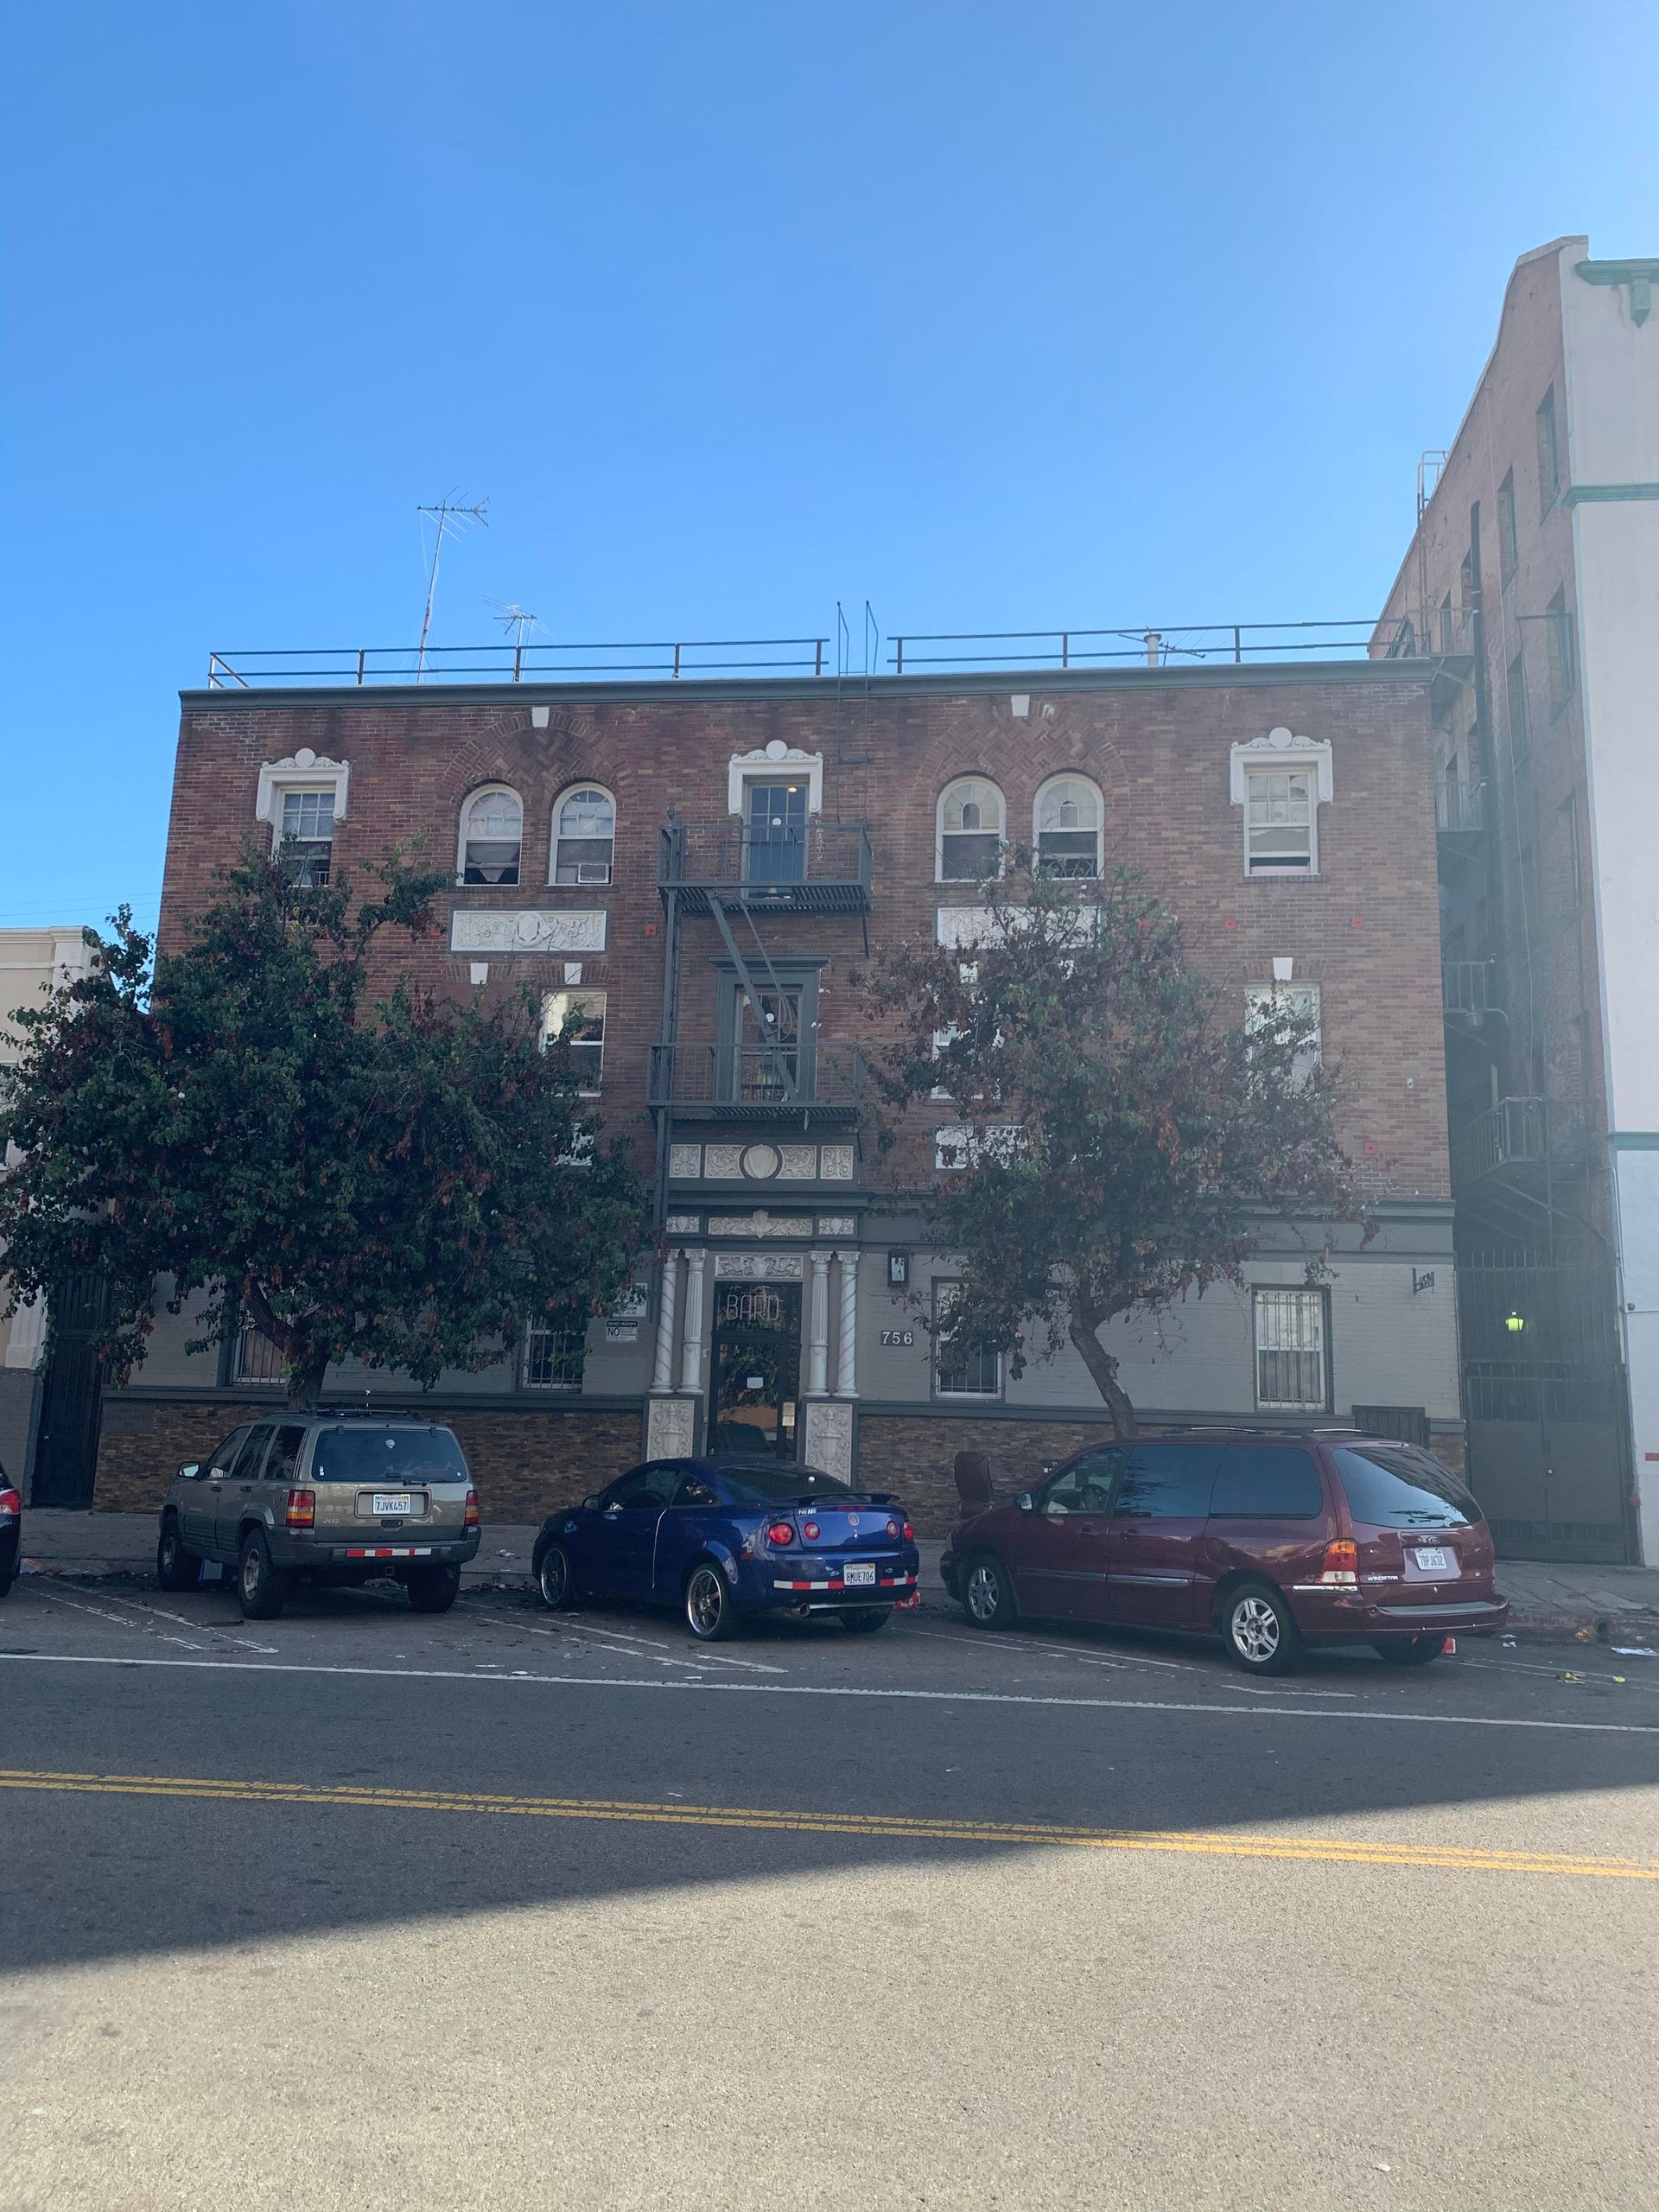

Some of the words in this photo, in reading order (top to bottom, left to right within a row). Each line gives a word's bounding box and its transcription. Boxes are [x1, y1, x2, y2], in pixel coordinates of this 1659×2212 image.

[727, 1294, 779, 1321] BARD
[607, 1327, 620, 1337] NO
[881, 1332, 912, 1344] 756
[375, 1501, 407, 1511] 7JVK457
[846, 1571, 874, 1583] 8MUE706
